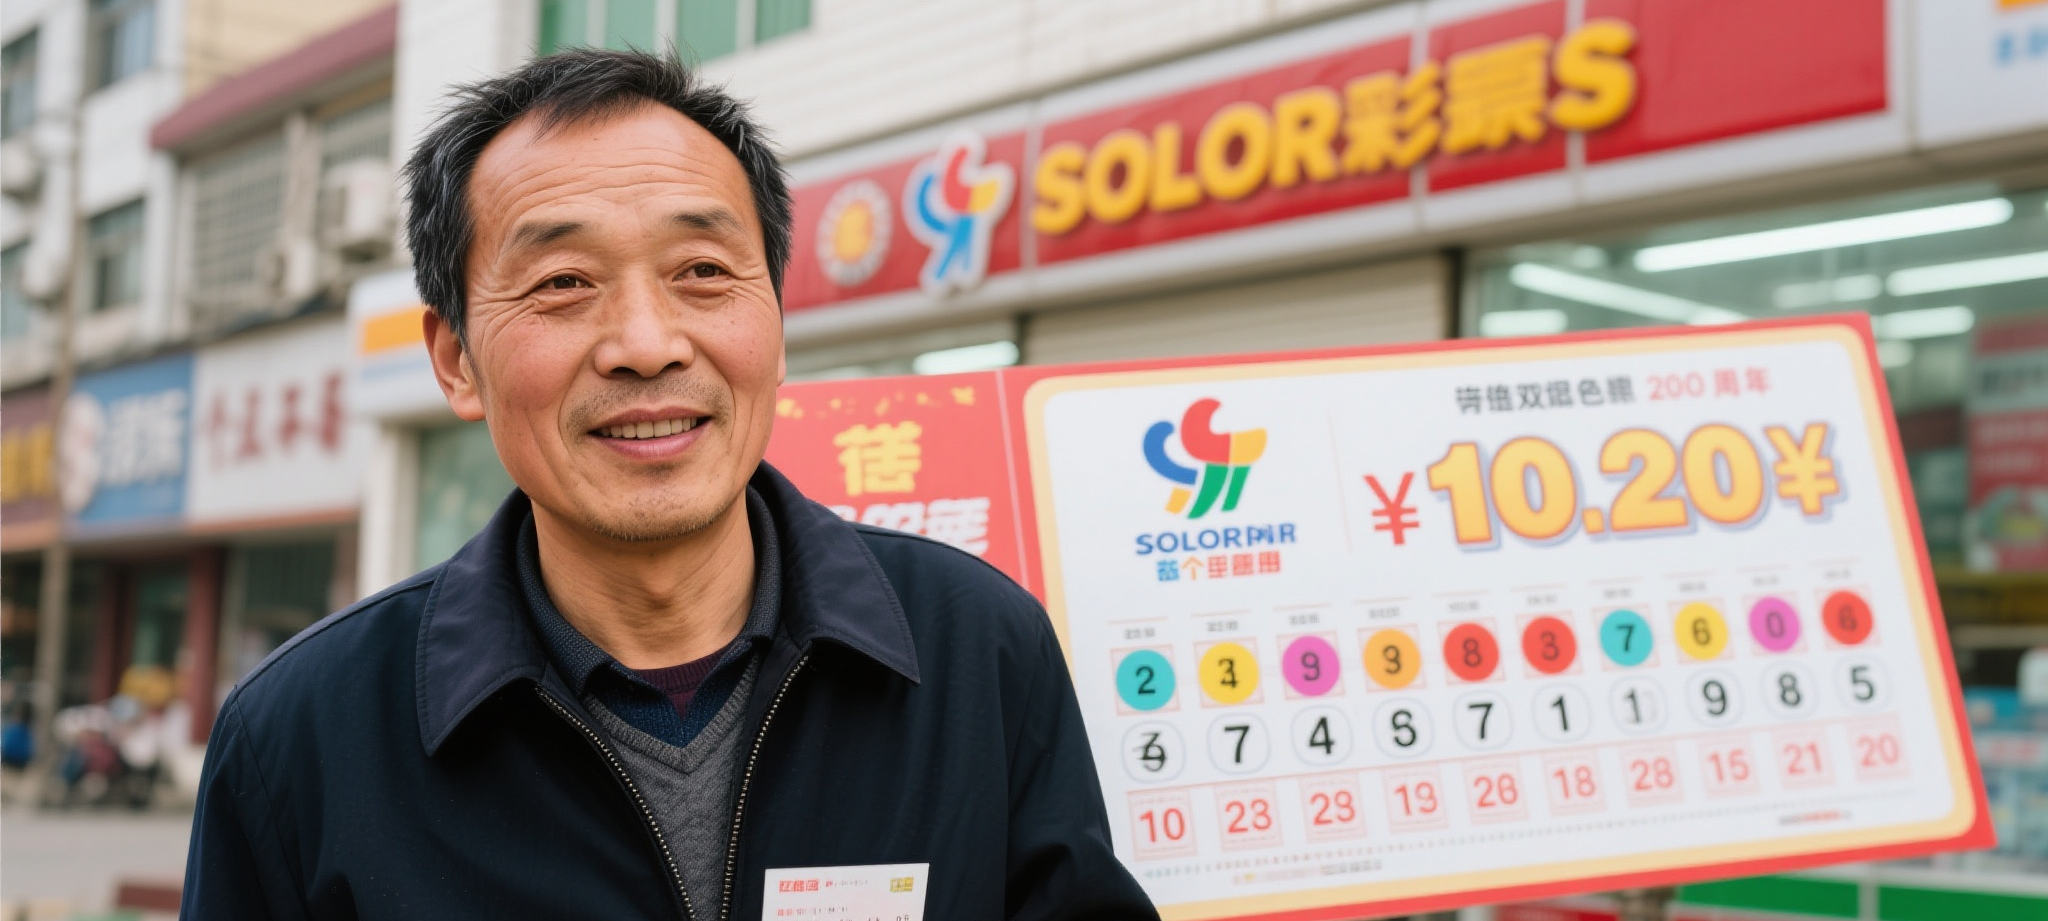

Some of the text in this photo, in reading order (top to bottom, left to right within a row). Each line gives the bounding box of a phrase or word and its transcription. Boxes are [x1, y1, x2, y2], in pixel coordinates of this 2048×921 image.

[1135, 666, 1156, 695] 2
[1616, 624, 1636, 652] 7
[1692, 618, 1712, 646] 6
[1765, 611, 1786, 639] 0
[1224, 725, 1250, 763] 7
[1309, 717, 1336, 755] 4
[1469, 703, 1494, 740] 7
[1551, 695, 1570, 732] 1
[1702, 680, 1728, 716] 9
[1778, 673, 1803, 708] 8
[1850, 665, 1875, 702] 5
[1139, 807, 1186, 843] 10
[1553, 765, 1597, 800] 18
[1708, 748, 1750, 783] 15
[1784, 742, 1823, 776] 21
[1858, 733, 1900, 769] 20
